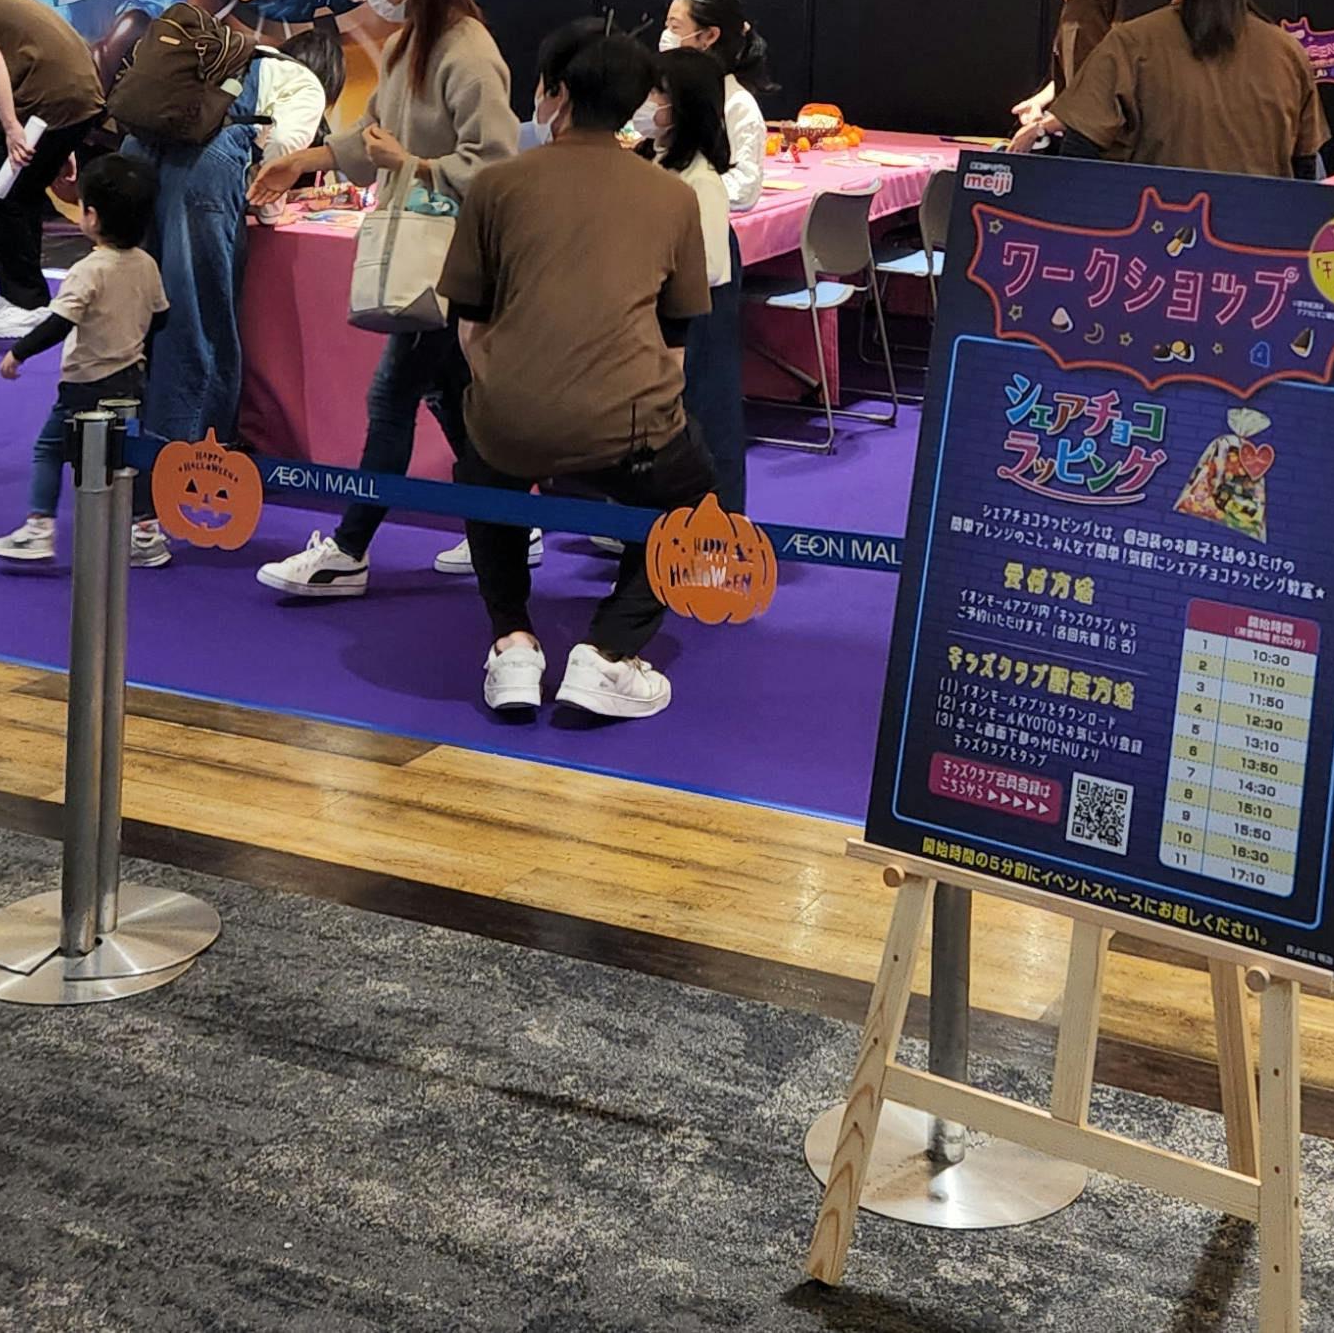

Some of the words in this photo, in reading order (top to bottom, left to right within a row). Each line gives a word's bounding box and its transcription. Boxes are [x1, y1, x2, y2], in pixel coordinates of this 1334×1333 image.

[966, 173, 1011, 194] meiji
[1003, 241, 1299, 330] ワークショップ
[1005, 373, 1166, 446] シェアチョコ
[195, 451, 223, 463] HAPPY
[998, 430, 1167, 496] ラッピング
[325, 473, 379, 499] MALL
[694, 538, 727, 555] HAPPY
[851, 540, 903, 565] MAL
[1202, 639, 1208, 650] 1
[1253, 649, 1290, 666] 10:30
[1198, 660, 1208, 672] 2
[1252, 671, 1286, 688] 11:10
[1196, 681, 1205, 693] 3
[1249, 693, 1284, 710] 11:50
[1194, 703, 1203, 714] 4
[1245, 714, 1283, 732] 12:30
[1191, 724, 1200, 735] 5
[1244, 735, 1280, 753] 13:10
[1188, 745, 1198, 757] 6
[1240, 757, 1279, 776] 13:50
[940, 777, 983, 799] こちらから
[1186, 766, 1196, 778] 7
[1238, 778, 1276, 798] 14:30
[1183, 788, 1193, 800] 8
[1237, 800, 1273, 819] 15:10
[1182, 810, 1191, 822] 9
[1234, 822, 1272, 842] 15:50
[1177, 830, 1192, 845] 10
[1231, 844, 1270, 864] 16:30
[1175, 852, 1188, 866] 11
[1230, 867, 1266, 886] 17:10
[922, 836, 1267, 946] 開始時間の5分前にイベントスペースにお越しください。
